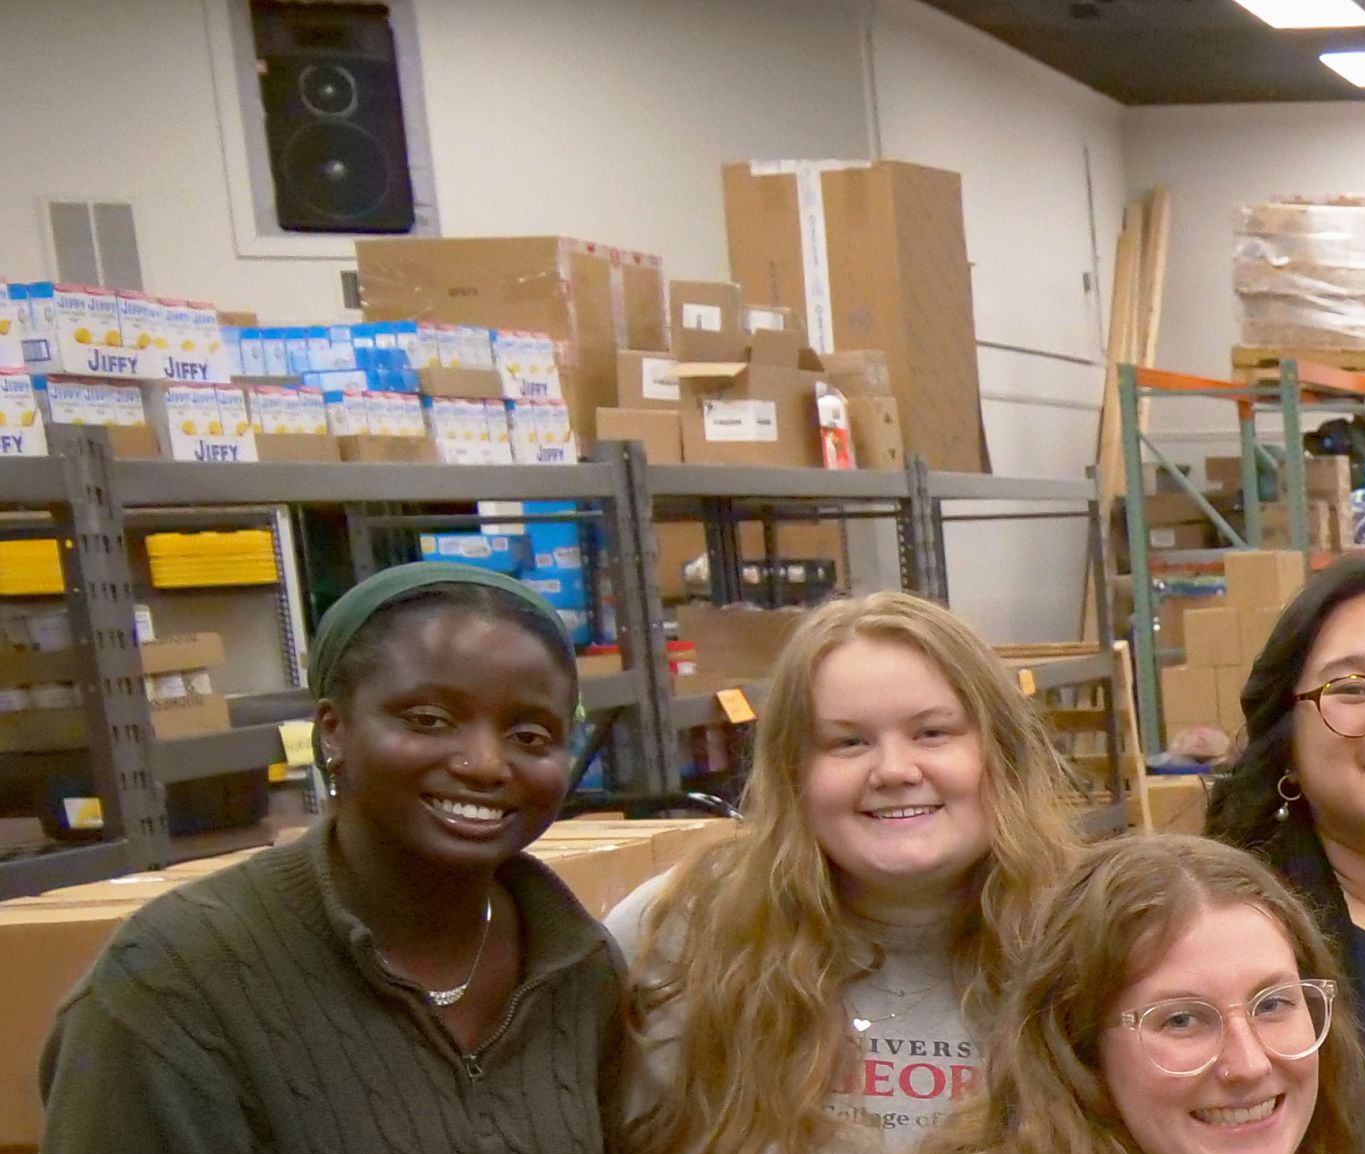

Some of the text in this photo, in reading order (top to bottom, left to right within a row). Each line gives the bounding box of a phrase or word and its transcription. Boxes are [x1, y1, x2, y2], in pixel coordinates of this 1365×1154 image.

[88, 349, 138, 374] JIFFY
[164, 357, 208, 380] JIFFY
[194, 439, 239, 462] JIFFY
[864, 1036, 984, 1058] IVERS
